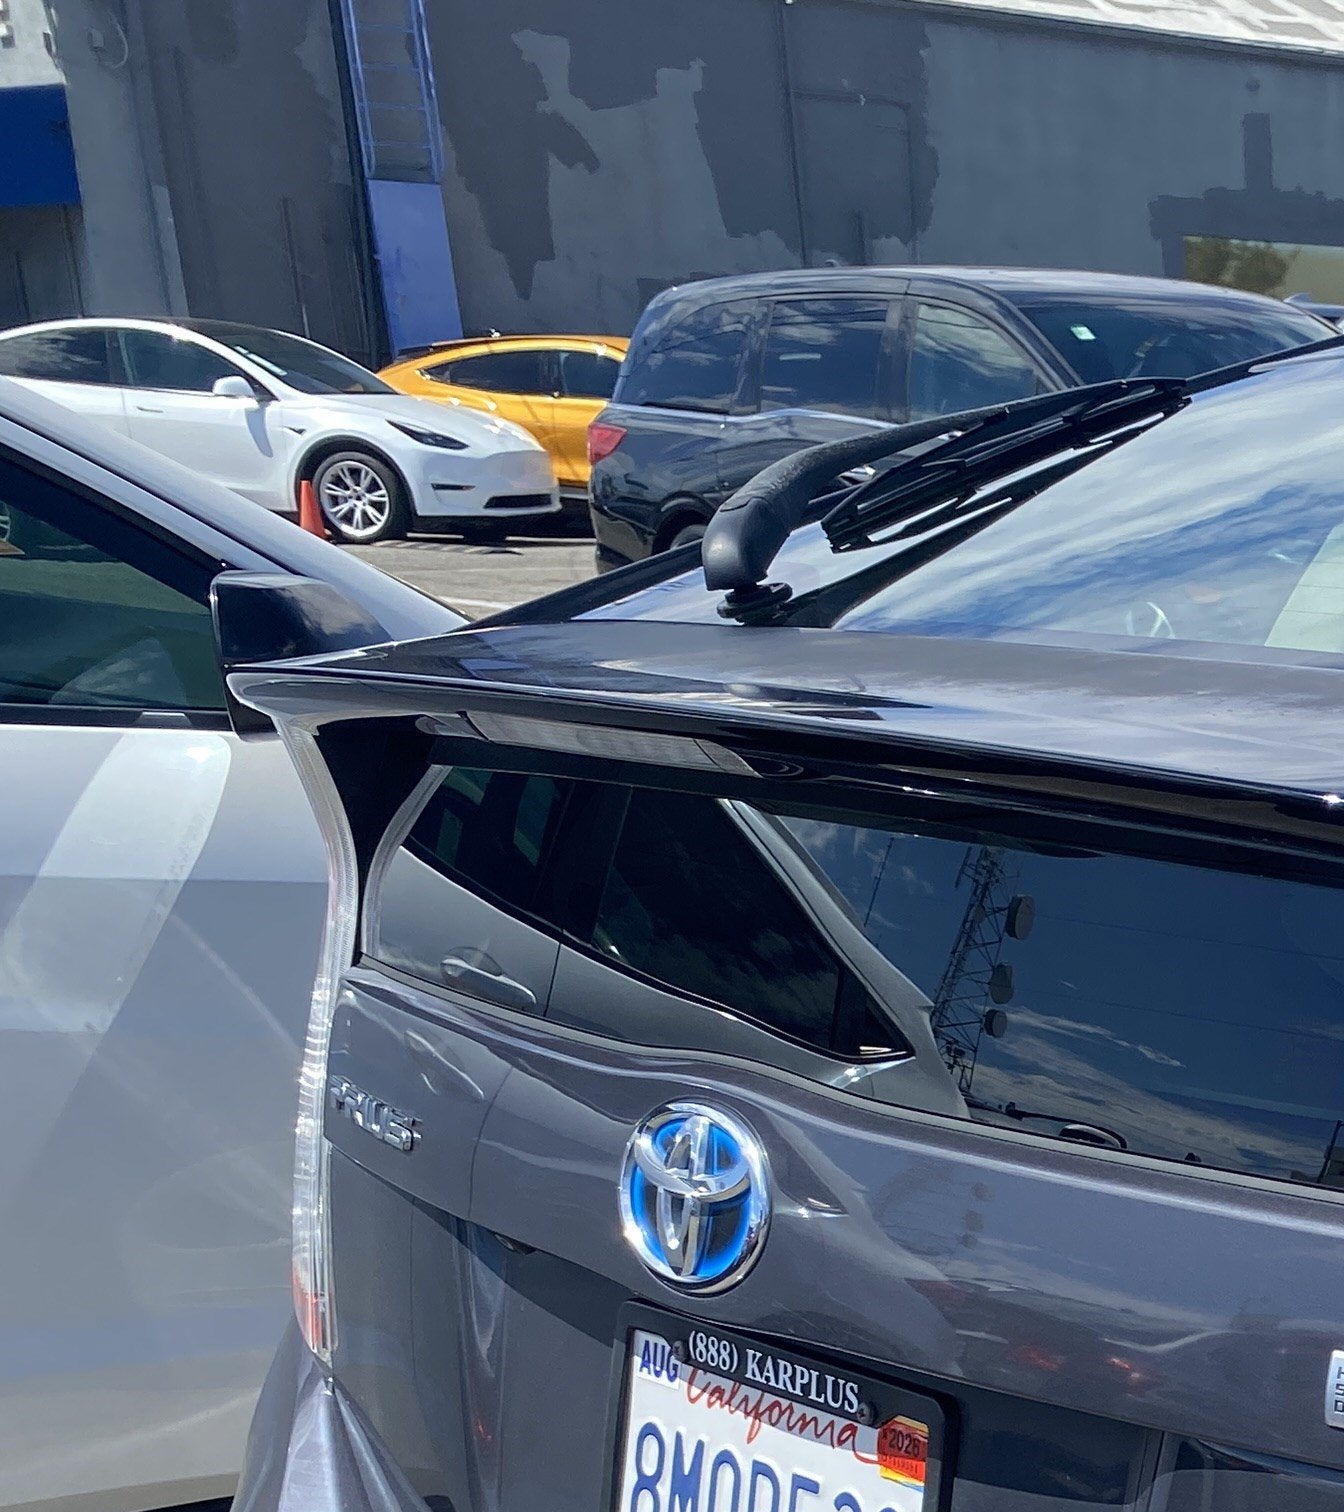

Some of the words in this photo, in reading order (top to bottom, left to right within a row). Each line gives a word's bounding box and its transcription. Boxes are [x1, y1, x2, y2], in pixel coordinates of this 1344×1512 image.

[639, 1339, 680, 1383] AUG
[688, 1330, 740, 1374] (888)
[744, 1347, 861, 1415] KARPLUS
[686, 1366, 873, 1462] California
[888, 1428, 921, 1458] 2026
